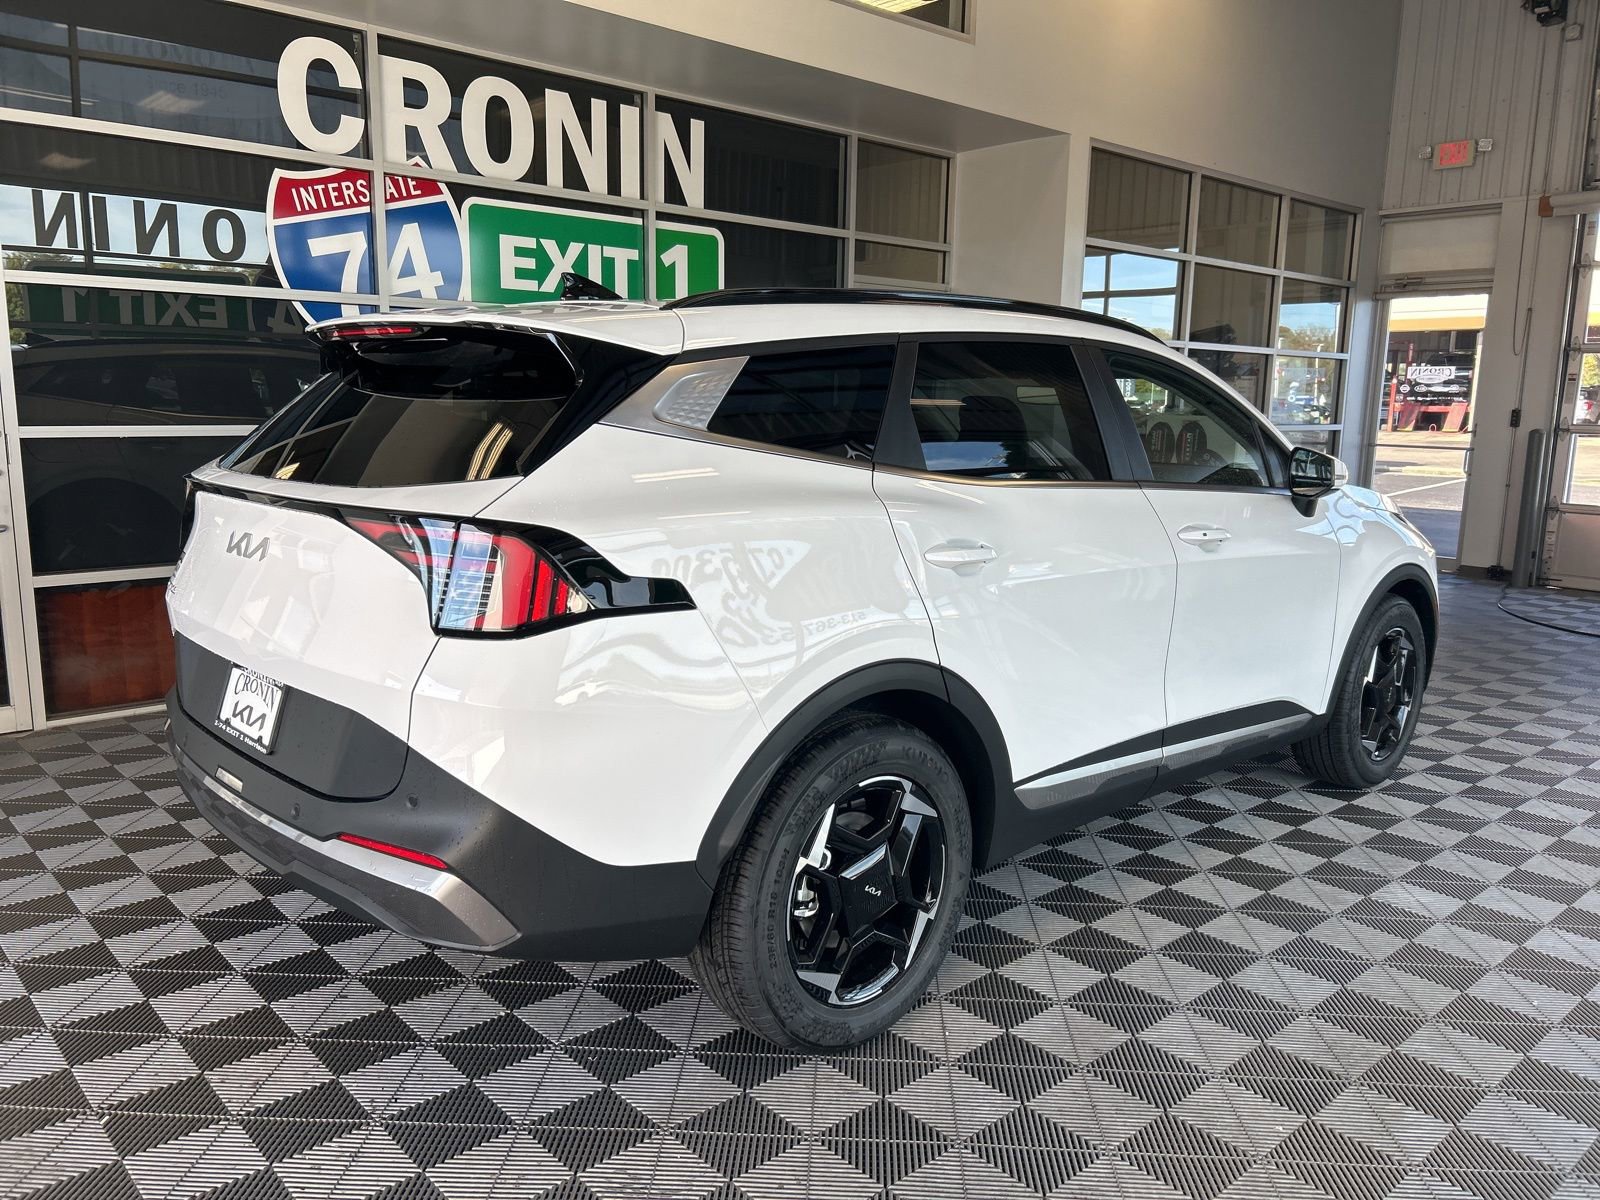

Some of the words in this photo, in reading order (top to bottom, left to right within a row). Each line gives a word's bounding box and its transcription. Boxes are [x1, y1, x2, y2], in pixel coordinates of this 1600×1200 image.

[277, 37, 704, 208] CRONIN
[291, 176, 422, 212] INTERSATE
[308, 222, 444, 316] 74
[499, 233, 640, 299] EXIT
[660, 244, 689, 299] 1
[226, 528, 271, 563] KIA
[234, 672, 279, 712] CRONIN
[231, 700, 267, 732] KIA
[864, 884, 882, 897] KIA
